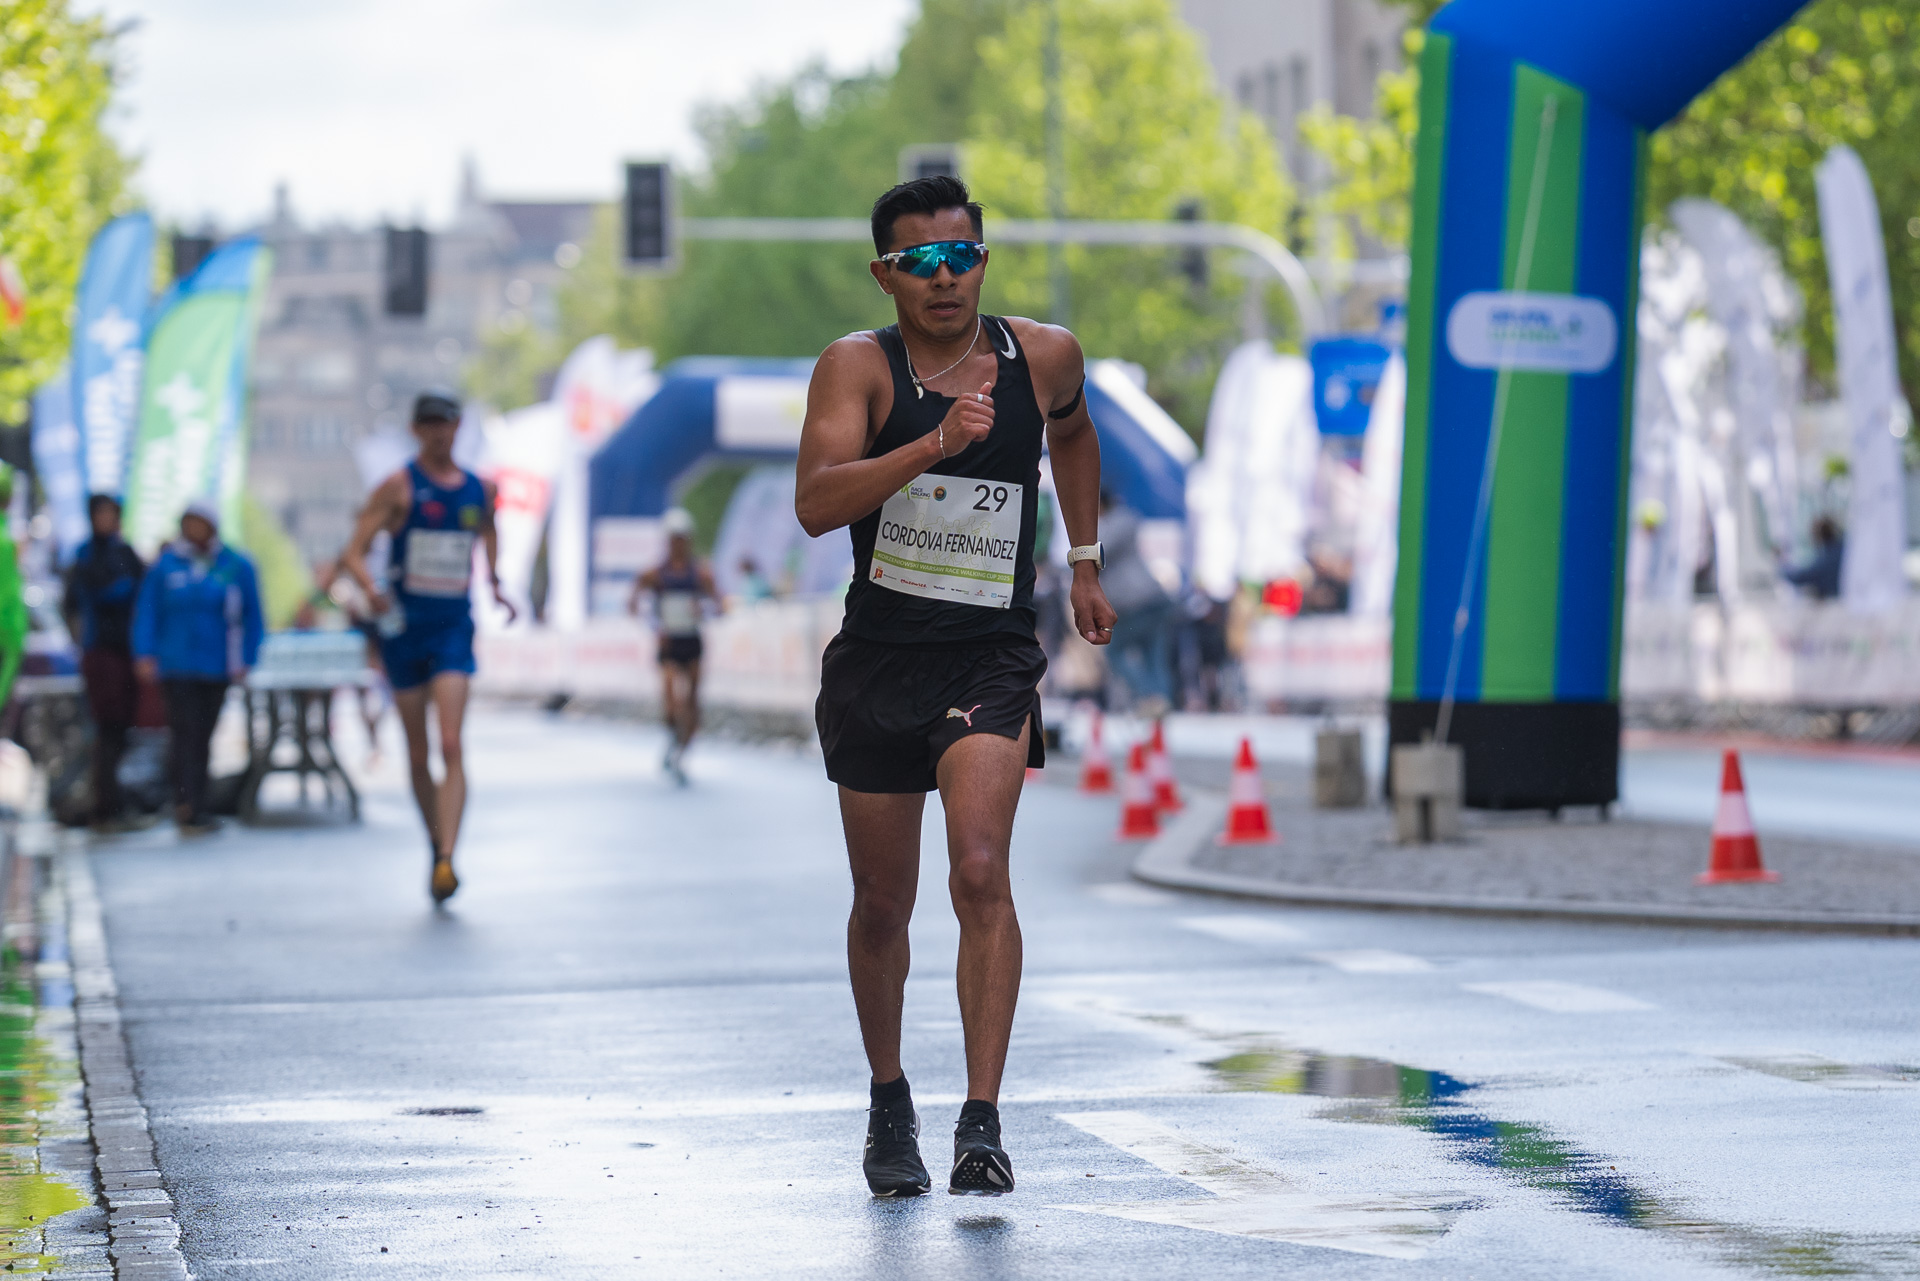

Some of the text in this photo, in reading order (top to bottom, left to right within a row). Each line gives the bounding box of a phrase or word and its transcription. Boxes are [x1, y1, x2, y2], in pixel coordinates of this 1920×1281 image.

[973, 484, 1008, 512] 29
[882, 521, 1015, 560] CORDOVA FERNANDEZ
[920, 564, 944, 572] WARSAW
[960, 570, 986, 578] WALKING
